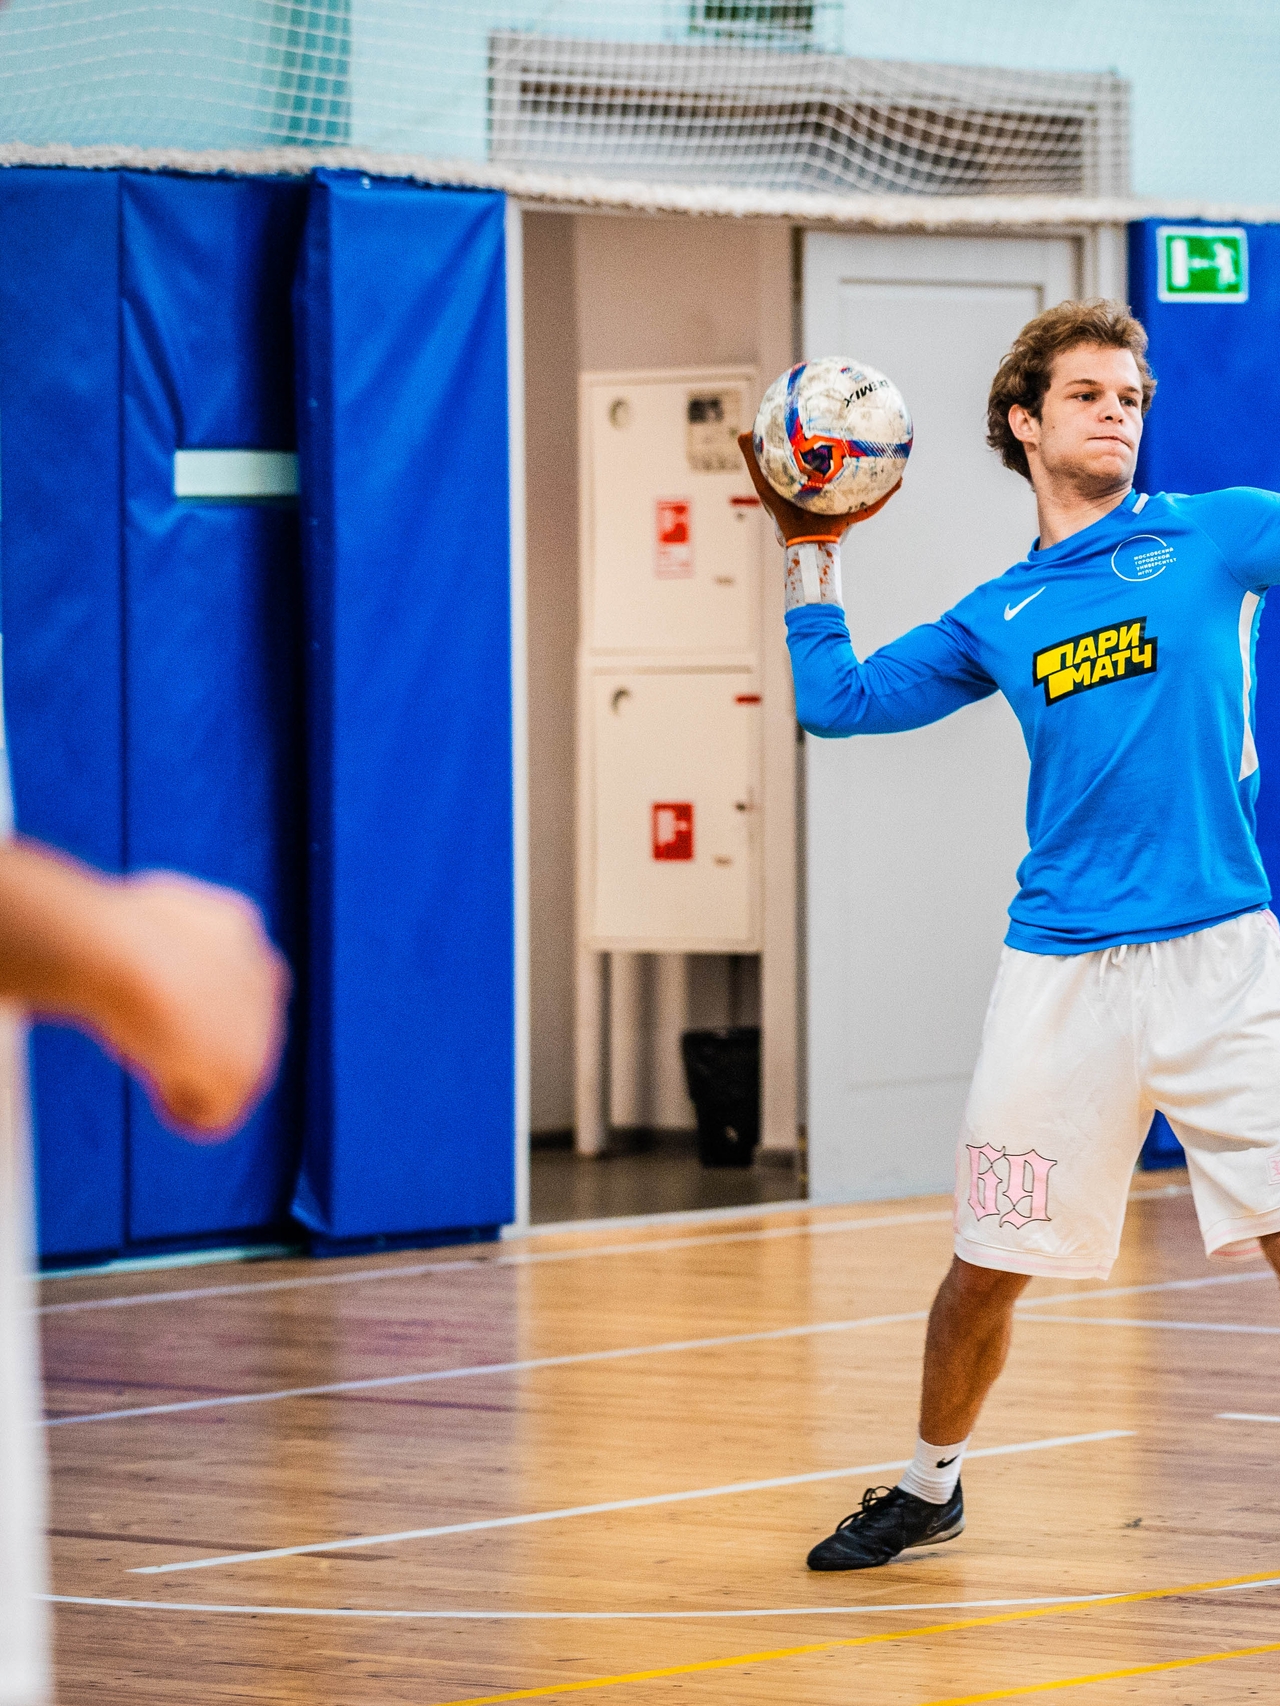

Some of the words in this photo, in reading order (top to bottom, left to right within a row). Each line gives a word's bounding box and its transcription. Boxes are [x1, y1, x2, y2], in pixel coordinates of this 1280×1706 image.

[1133, 547, 1174, 561] МОСКОВСКИЙ
[1134, 553, 1171, 566] ГОРОДСКОЙ
[1135, 557, 1177, 571] УНИВЕРСИТЕТ
[1037, 623, 1141, 679] ПАРИ
[1048, 643, 1152, 699] МАТЧ
